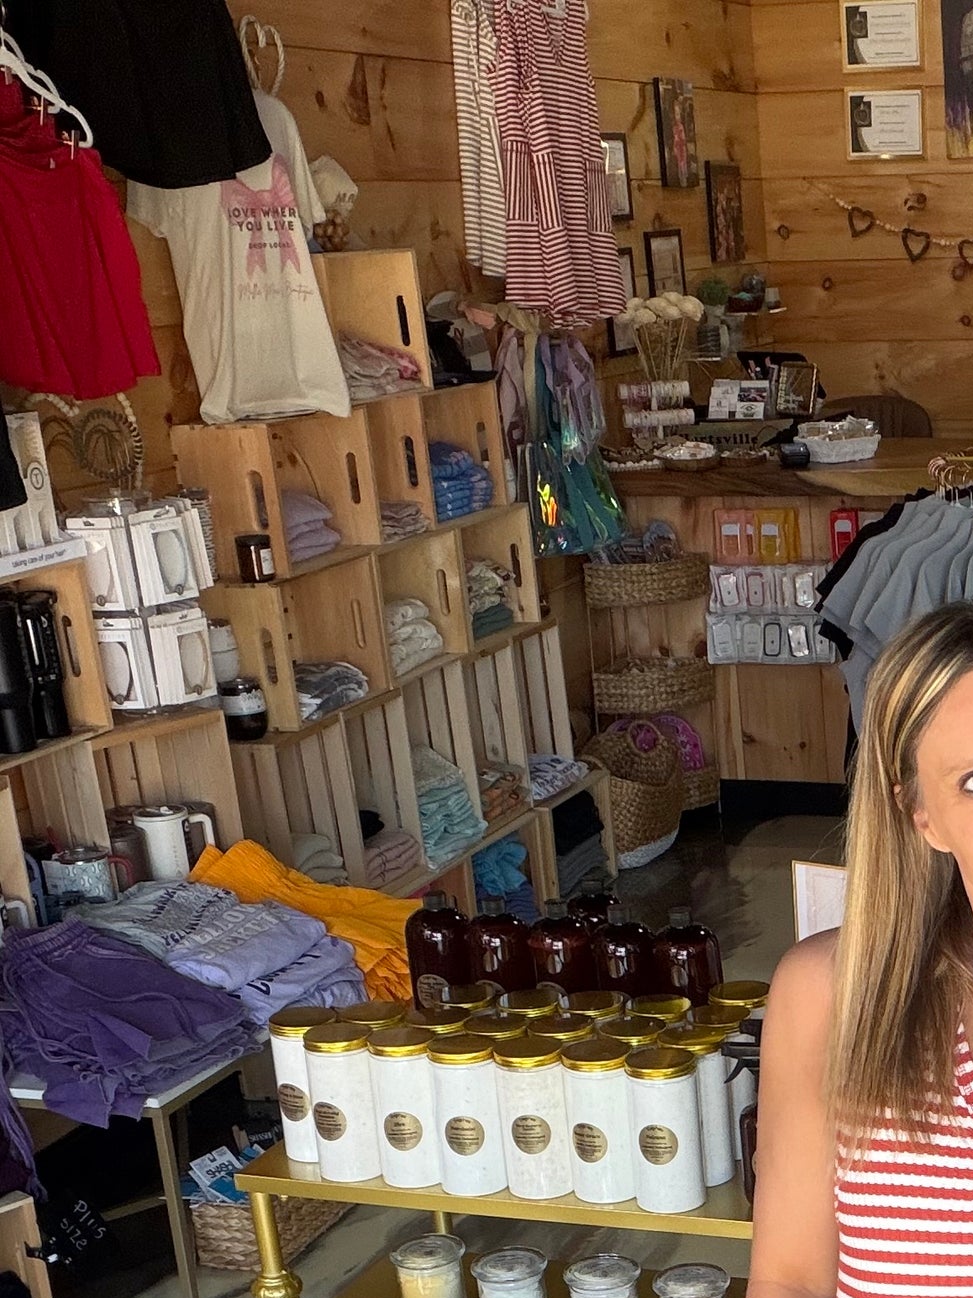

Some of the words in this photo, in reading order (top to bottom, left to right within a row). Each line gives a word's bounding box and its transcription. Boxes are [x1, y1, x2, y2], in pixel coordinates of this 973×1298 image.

[260, 207, 297, 218] WHER
[237, 221, 263, 232] YOU
[267, 221, 295, 232] LIVE
